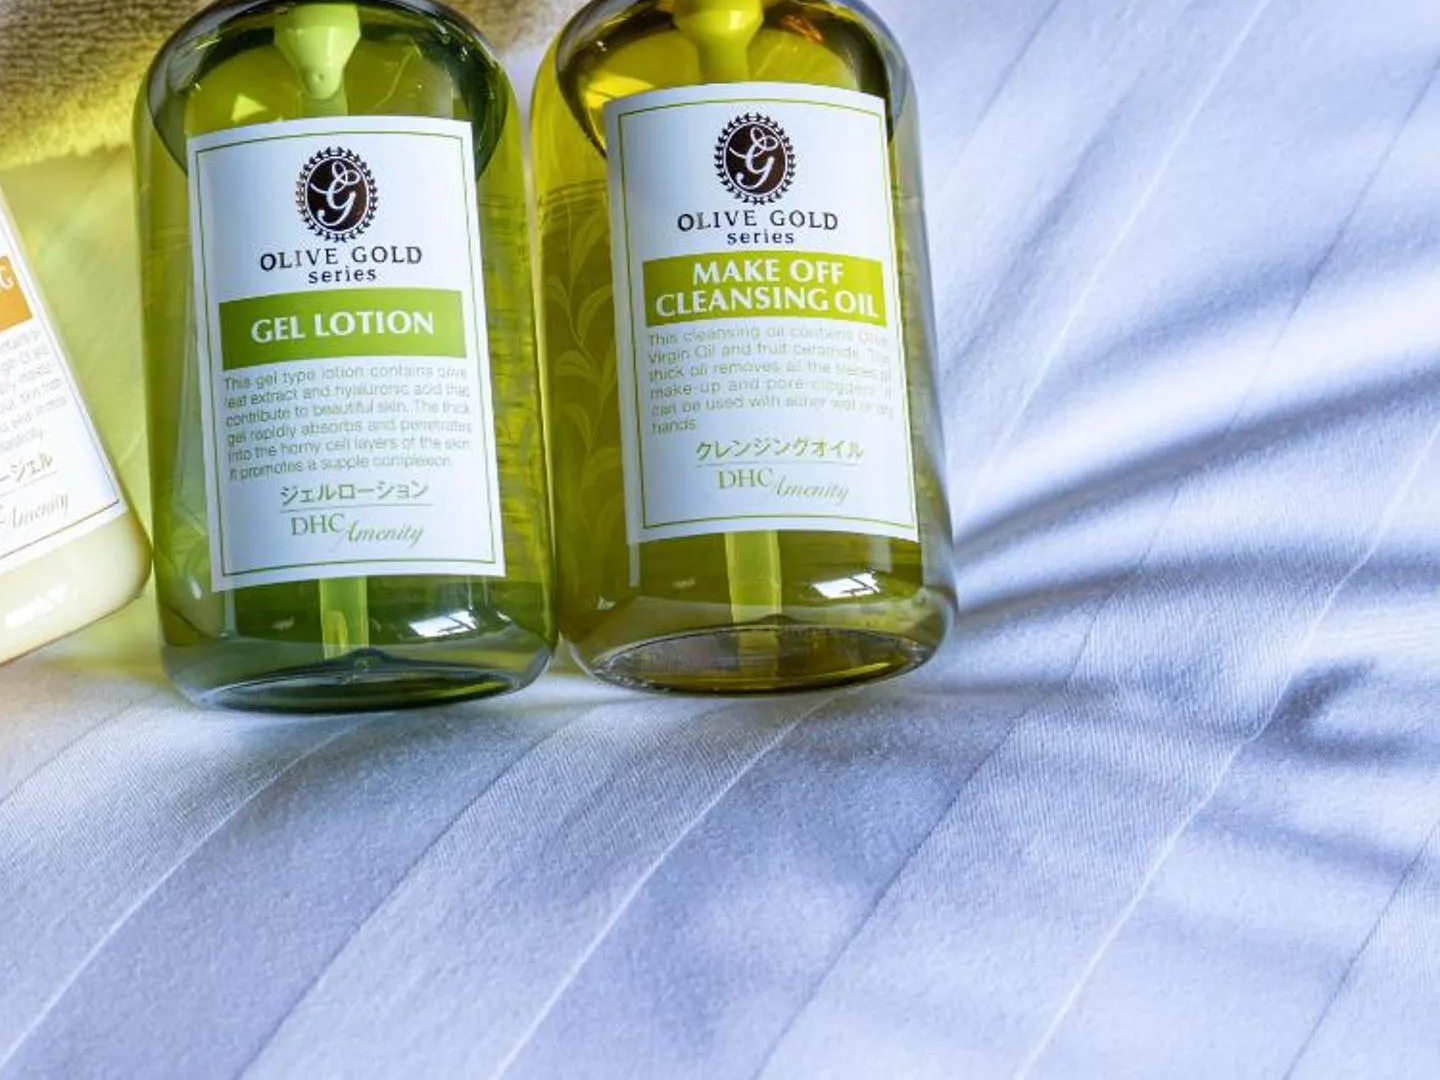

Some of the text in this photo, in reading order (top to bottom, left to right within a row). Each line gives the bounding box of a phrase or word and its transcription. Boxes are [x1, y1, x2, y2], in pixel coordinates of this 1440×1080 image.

[677, 209, 839, 232] OLIVE GOLD
[726, 228, 796, 245] series
[260, 245, 423, 272] OLIVE GOLD
[308, 266, 377, 285] series
[692, 259, 845, 285] MAKE OFF
[655, 287, 880, 319] CLEANSING OIL
[251, 309, 435, 344] GEL LOTION
[648, 331, 677, 345] This
[682, 326, 760, 345] cleansing
[766, 326, 784, 337] oil
[648, 347, 690, 367] Virgin
[694, 345, 715, 358] Oil
[721, 344, 751, 356] and
[757, 343, 788, 354] fruit
[224, 375, 250, 390] This
[256, 372, 277, 389] gel
[283, 369, 315, 386] type
[321, 366, 363, 379] lotion
[649, 365, 683, 382] thick
[689, 363, 706, 376] oil
[712, 363, 779, 373] removes
[727, 377, 759, 390] and
[250, 388, 298, 404] extract
[303, 385, 329, 398] and
[682, 398, 701, 411] be
[706, 395, 743, 409] used
[749, 395, 780, 406] with
[225, 408, 290, 427] contribute
[295, 406, 308, 418] to
[250, 424, 296, 444] rapidly
[255, 444, 276, 457] the
[326, 438, 350, 450] cell
[695, 436, 866, 463] クレンジングオイル
[717, 467, 773, 491] DHC
[279, 478, 431, 506] ジェルローション
[291, 512, 345, 537] DHC
